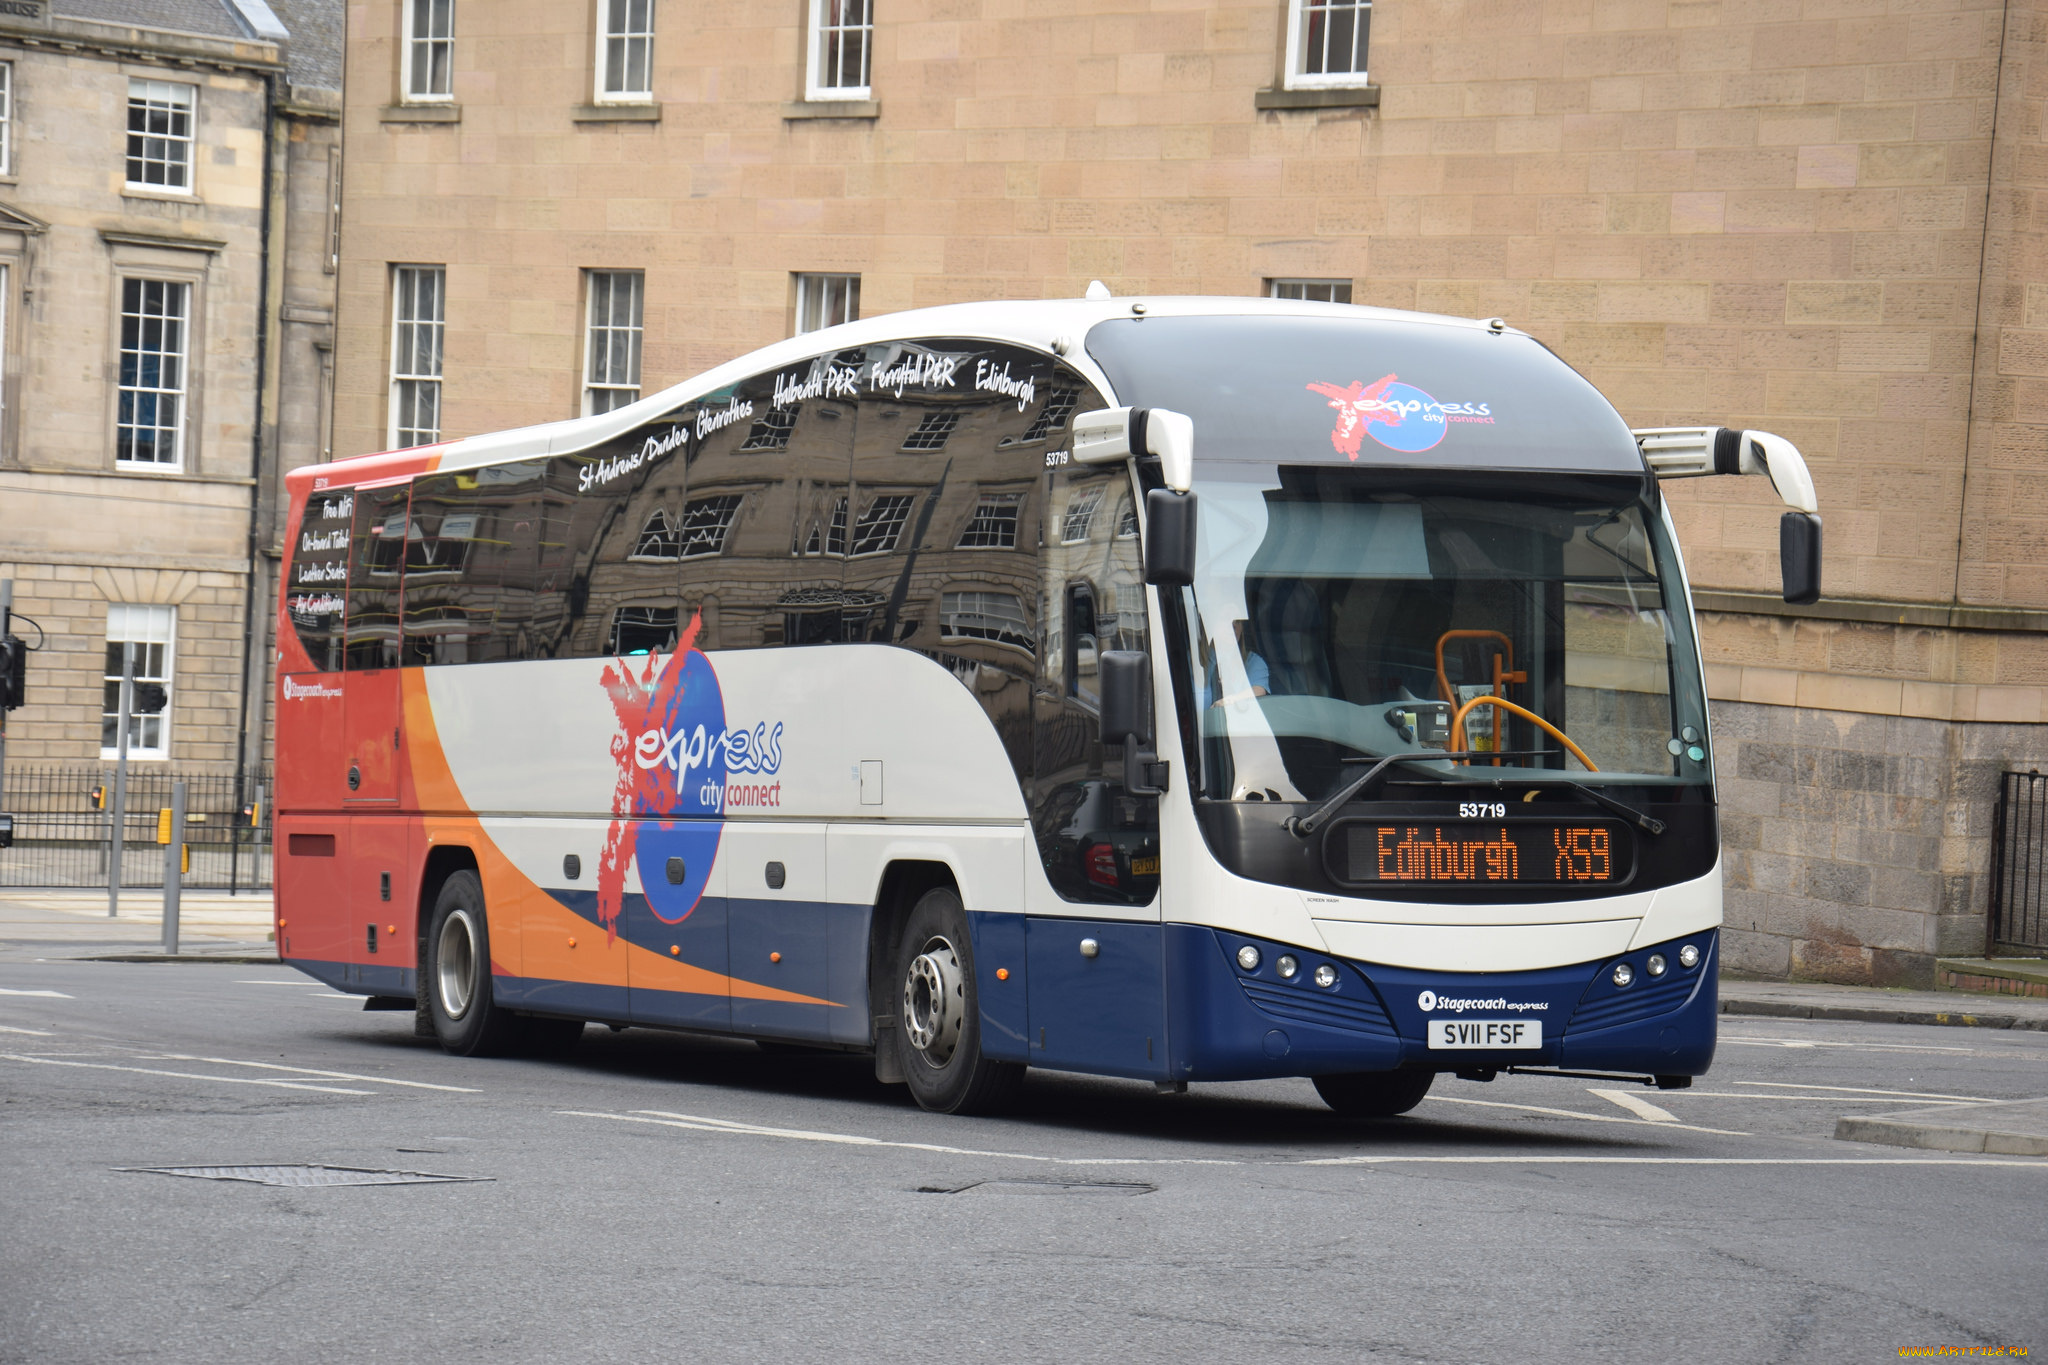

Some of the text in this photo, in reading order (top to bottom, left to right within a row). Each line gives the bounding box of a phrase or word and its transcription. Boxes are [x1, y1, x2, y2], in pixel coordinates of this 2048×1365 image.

[0, 1, 40, 17] OUSE
[1352, 398, 1491, 418] express
[578, 352, 1035, 493] St Andrews/Dundee Glenrothes Halbeath P&R Ferrytoll P&R Edinburgh
[1423, 413, 1496, 425] city connect
[1046, 450, 1068, 467] 53719
[322, 499, 338, 519] Free
[302, 528, 350, 552] On-board Toilet
[298, 560, 347, 584] Leather Seats
[296, 592, 345, 619] Air Conditioning
[291, 682, 343, 701] Stagecoach express
[634, 721, 783, 795] express
[700, 778, 781, 814] city connect
[1459, 803, 1506, 818] 53719
[1377, 827, 1610, 880] Edinburgh X59
[1436, 996, 1549, 1013] Stagecoach express
[1444, 1023, 1525, 1044] SV11 FSF
